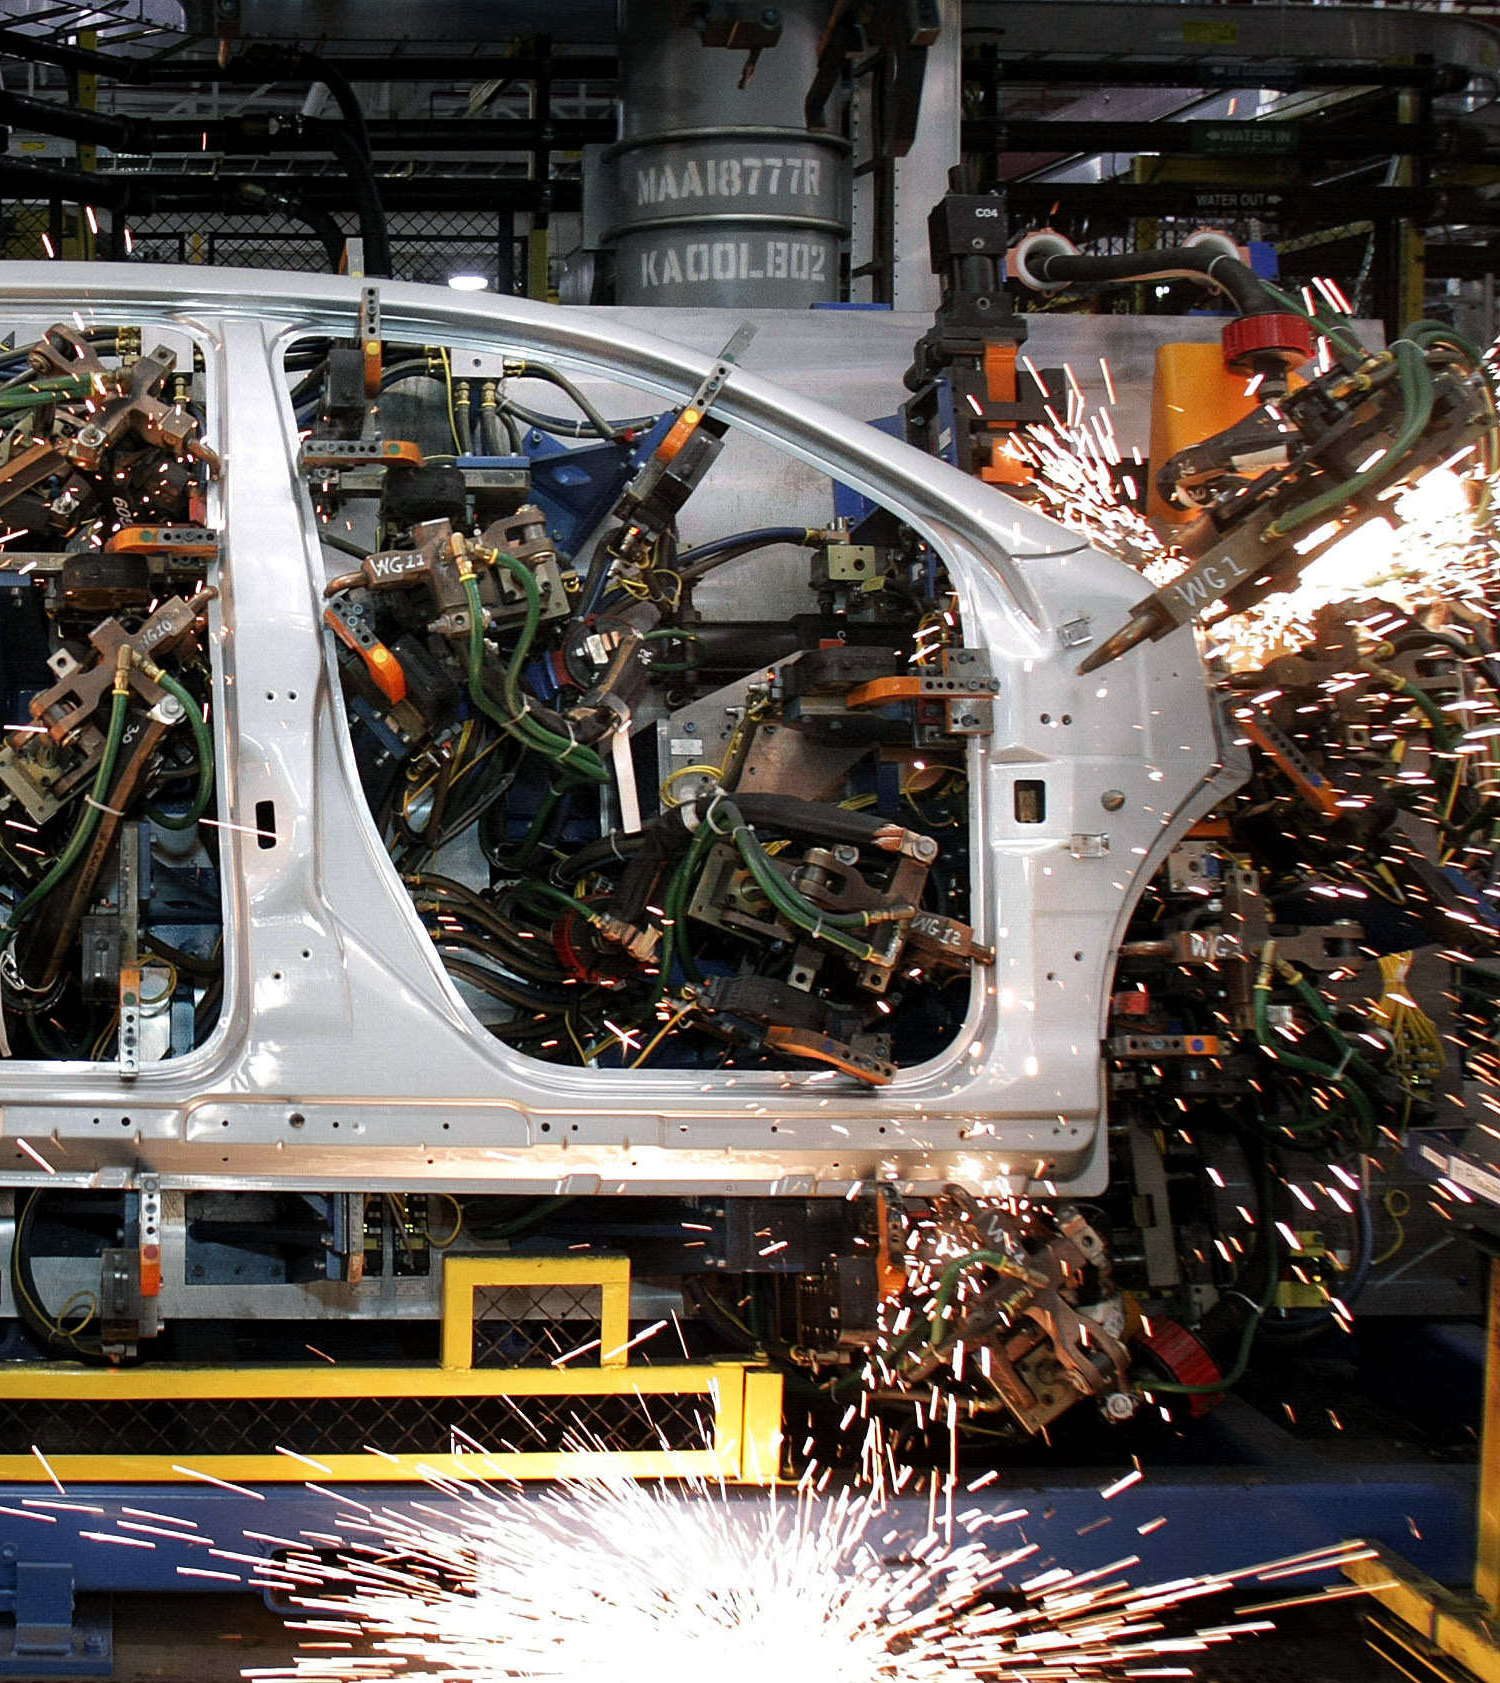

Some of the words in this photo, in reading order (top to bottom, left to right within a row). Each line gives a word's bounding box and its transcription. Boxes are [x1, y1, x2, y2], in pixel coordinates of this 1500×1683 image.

[1221, 129, 1273, 142] WATER
[1196, 193, 1238, 206] WATER
[1241, 193, 1266, 206] OUT
[369, 553, 425, 577] WG11
[1174, 555, 1248, 607] WG1
